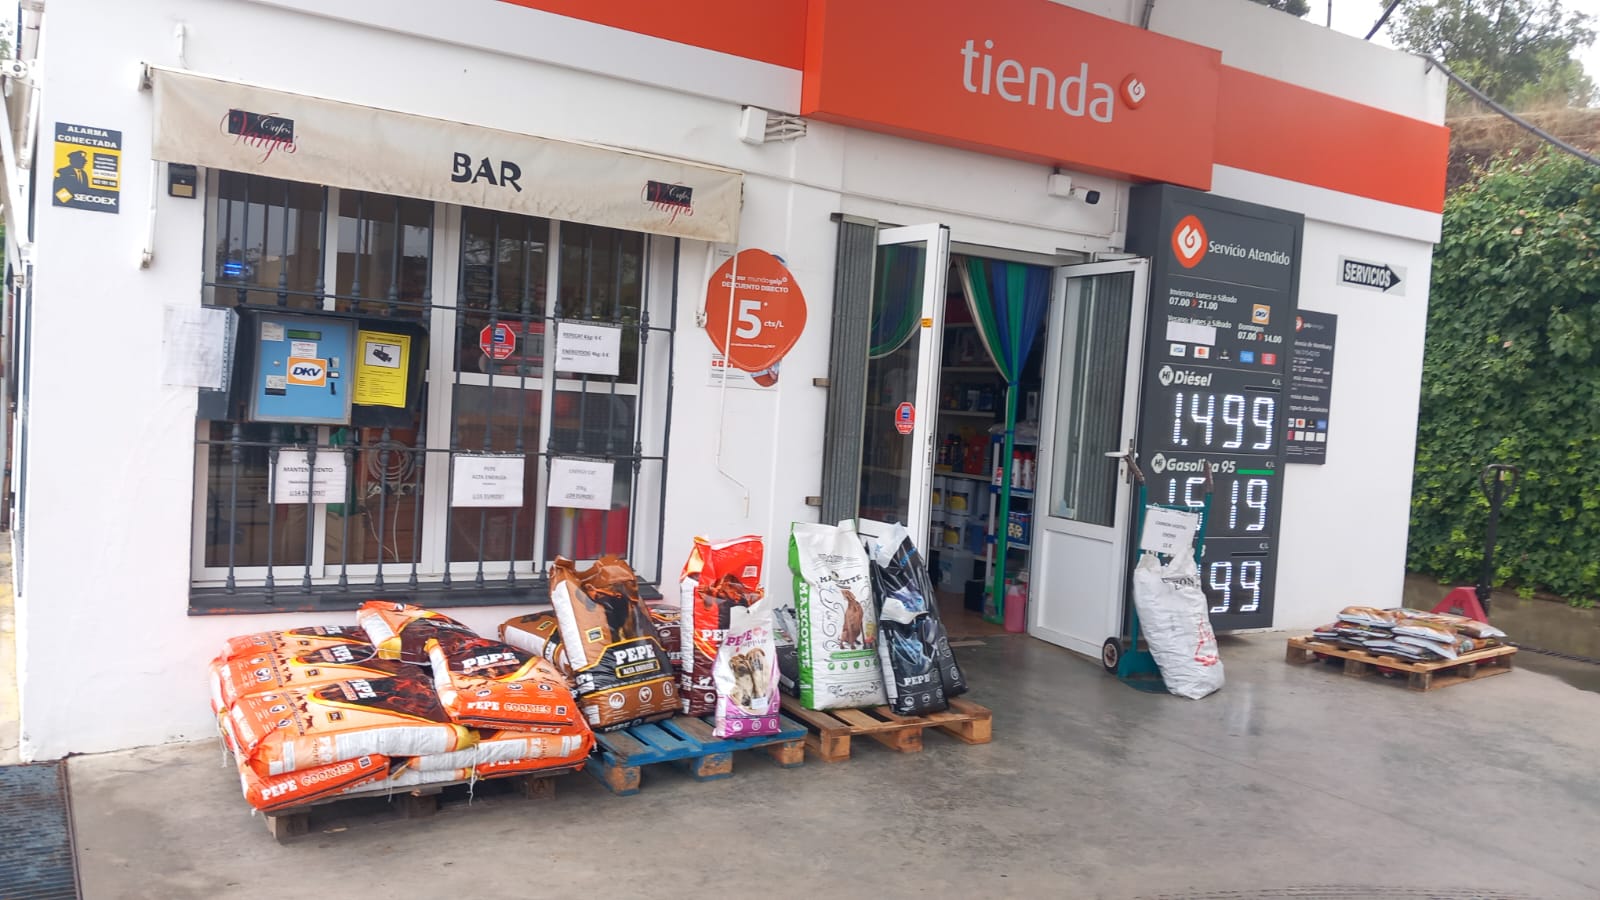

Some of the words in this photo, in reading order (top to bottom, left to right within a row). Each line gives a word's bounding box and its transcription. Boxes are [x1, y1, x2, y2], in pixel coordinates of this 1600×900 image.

[960, 39, 1115, 123] tienda
[67, 125, 109, 138] ALARMA
[56, 134, 118, 149] CONECTADA
[450, 151, 523, 193] BAR
[73, 193, 118, 206] SECOEX
[1208, 240, 1246, 259] Servicio
[1247, 248, 1291, 266] Atendido
[1345, 262, 1391, 288] SERVICIOS
[1168, 296, 1191, 307] 07.00
[763, 319, 785, 329] cts/L
[1237, 331, 1258, 341] 07.00
[292, 366, 322, 378] DKV
[1173, 370, 1213, 388] Diésel
[1172, 392, 1275, 450] 1.499
[1221, 461, 1237, 474] 95
[799, 580, 811, 670] MAXCOTTE
[461, 651, 519, 670] PEPE
[613, 643, 657, 666] PEPE
[902, 674, 931, 688] PEPE
[466, 701, 501, 712] PEPE
[503, 702, 552, 715] COOKIES
[260, 779, 299, 802] PEPE
[301, 762, 356, 788] COOKIES
